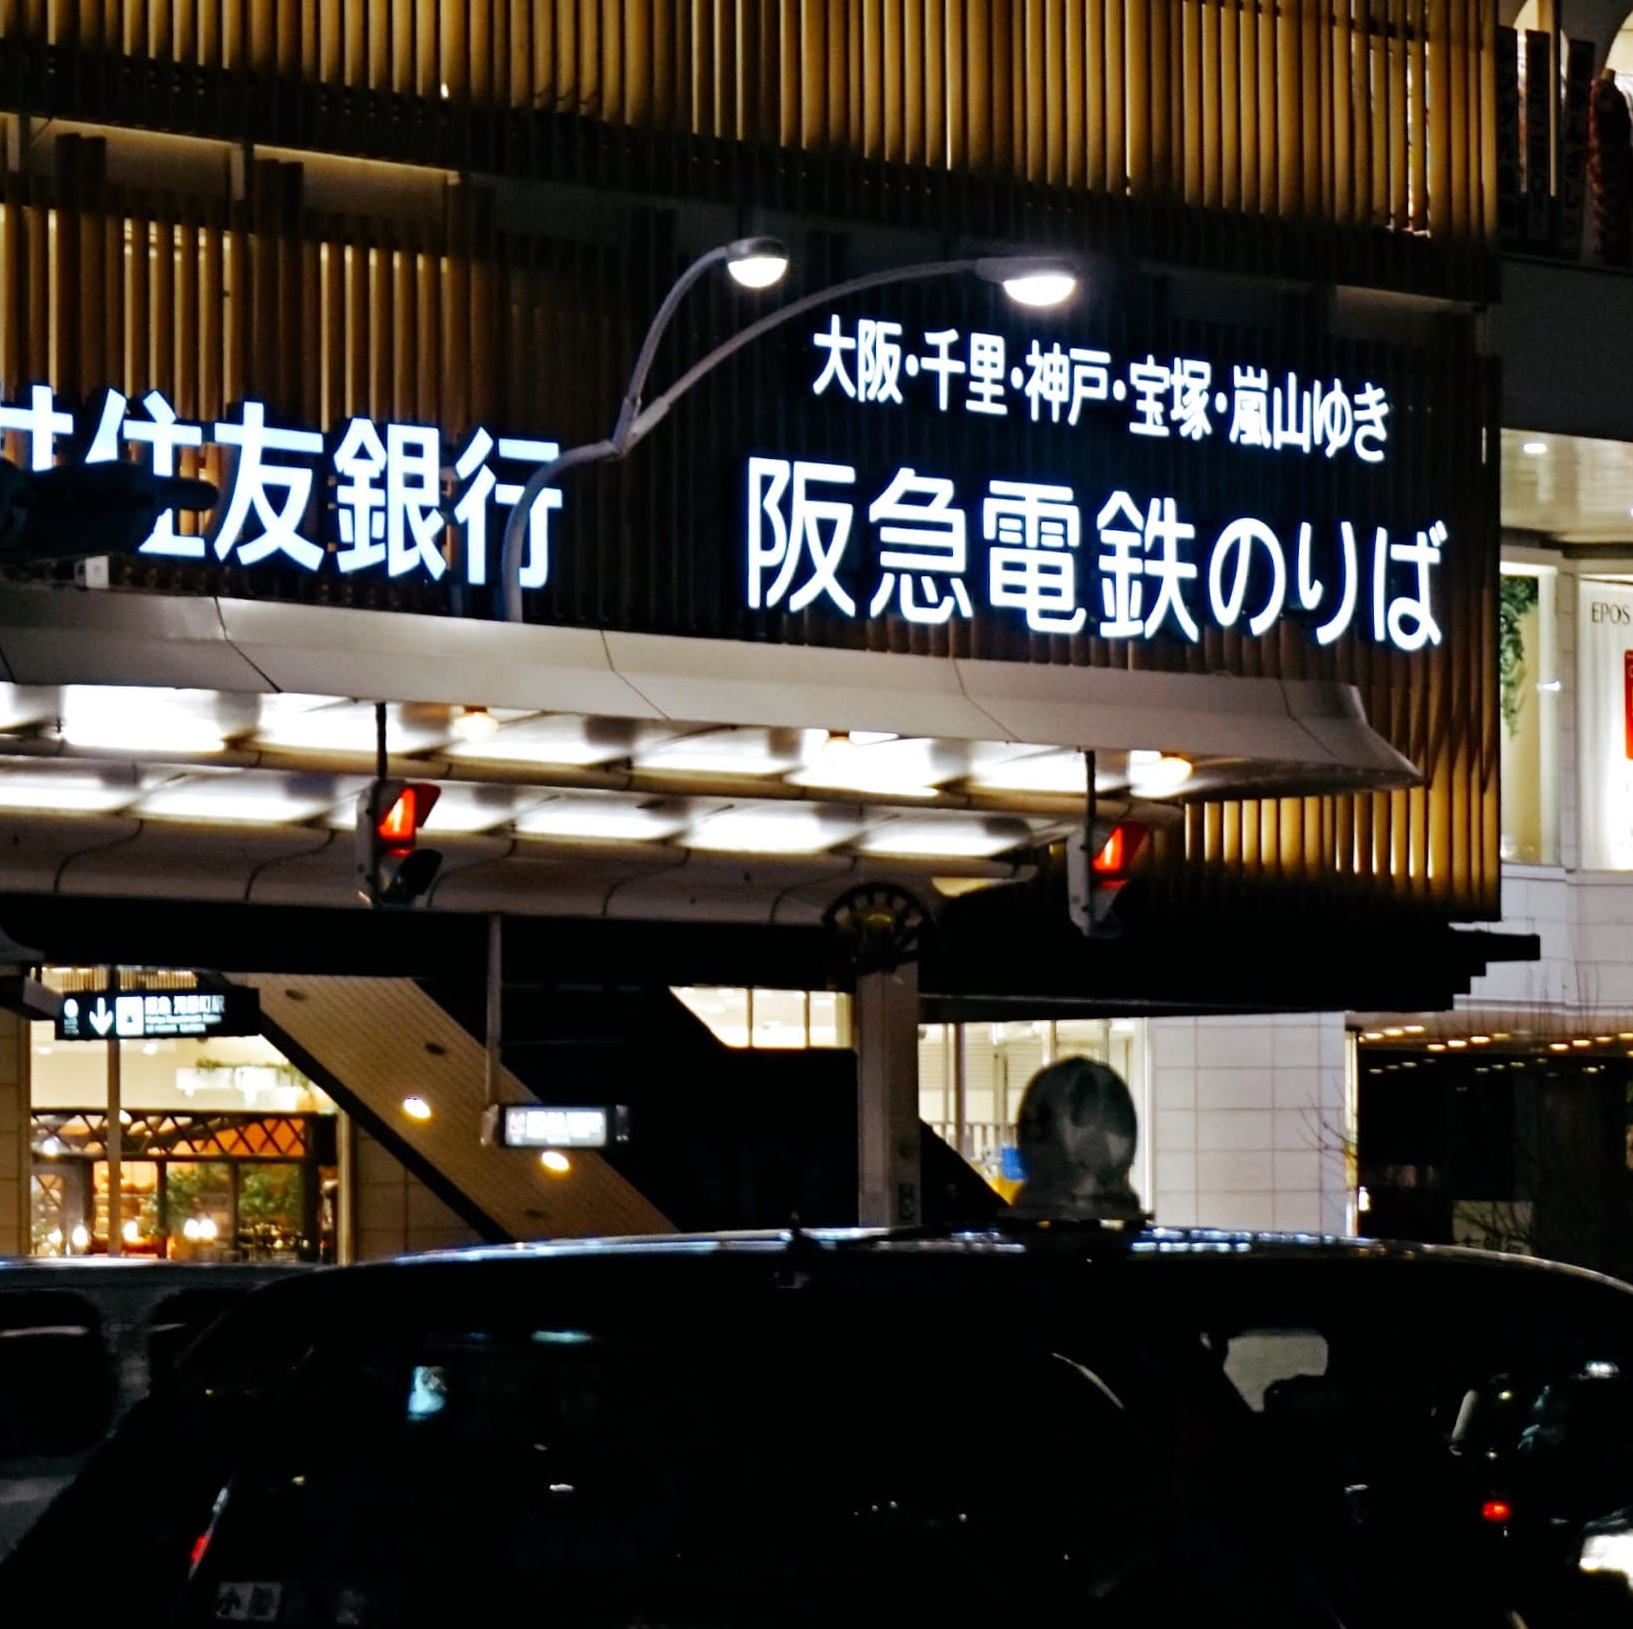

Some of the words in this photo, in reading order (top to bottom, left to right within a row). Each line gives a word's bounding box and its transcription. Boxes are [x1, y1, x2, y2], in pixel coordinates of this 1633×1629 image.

[746, 456, 1450, 652] 阪急電鉄のりば
[1591, 601, 1631, 625] EPOS
